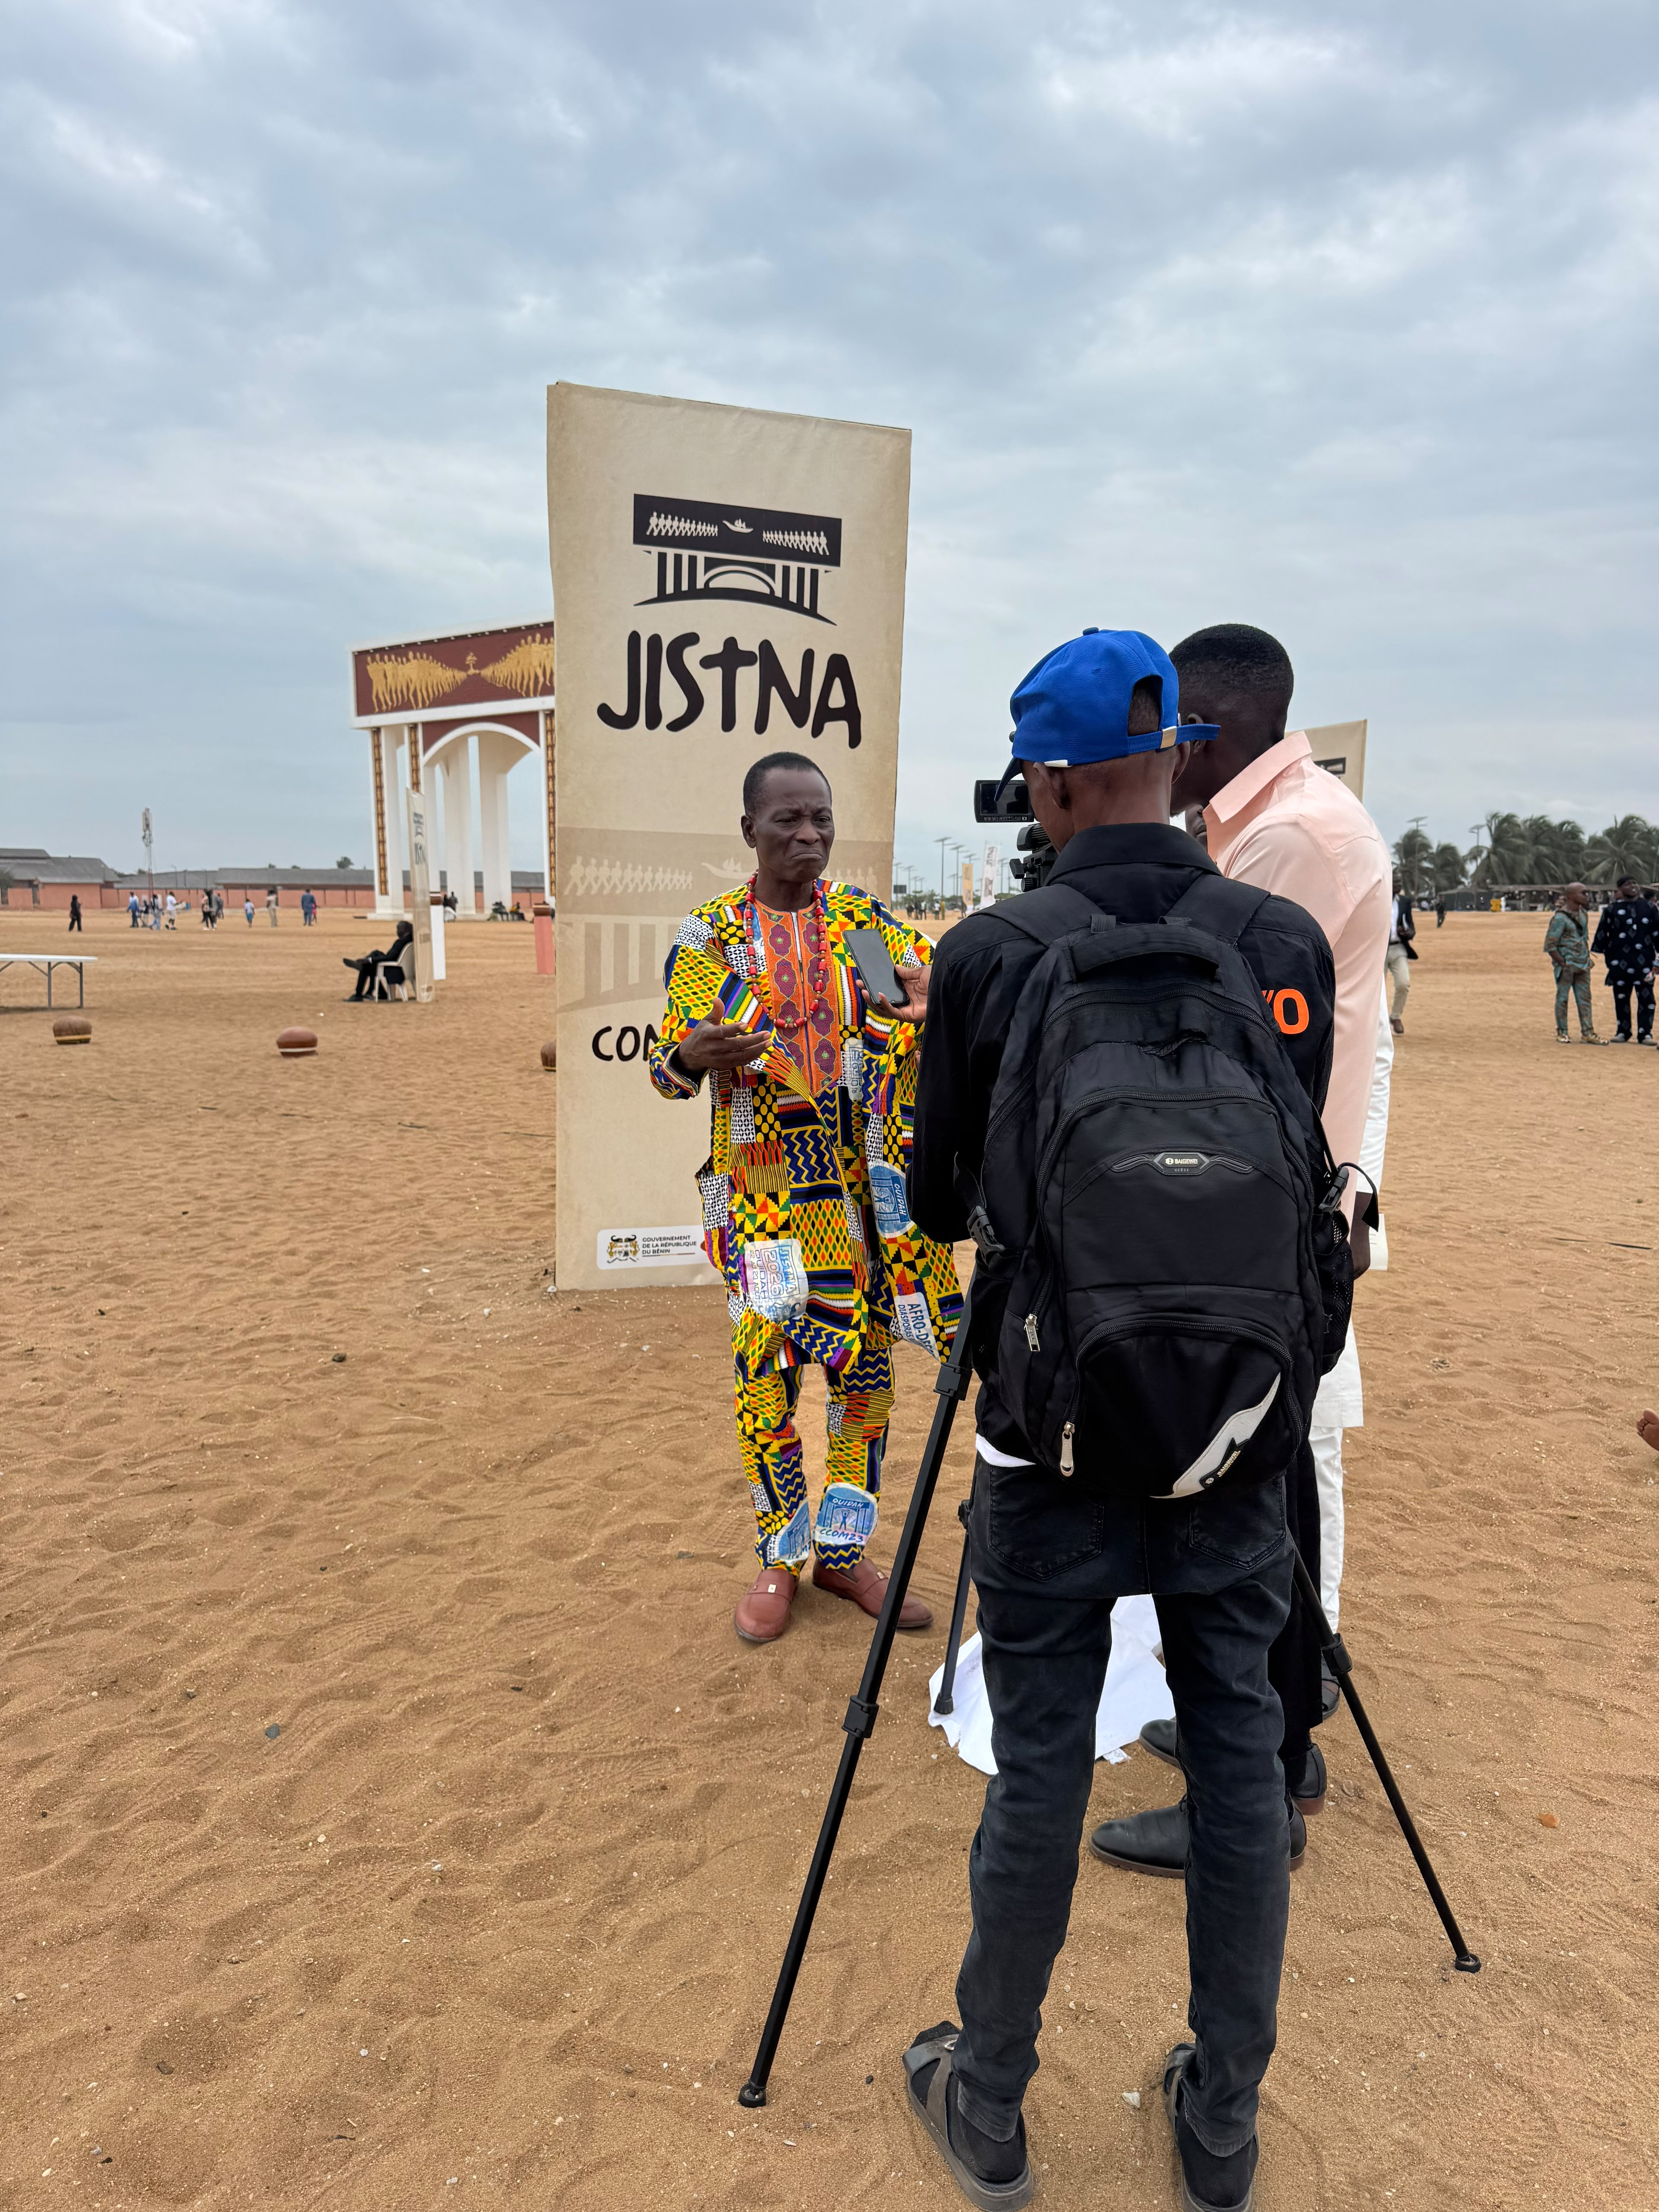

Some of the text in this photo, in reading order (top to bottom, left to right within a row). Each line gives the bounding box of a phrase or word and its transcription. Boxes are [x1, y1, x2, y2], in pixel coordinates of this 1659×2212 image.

[597, 630, 861, 749] JISTNA
[894, 1183, 907, 1216] OUIDAH
[756, 1249, 768, 1299] OUIDAH
[764, 1250, 784, 1296] 2026
[898, 1304, 913, 1339] DIASPORAS
